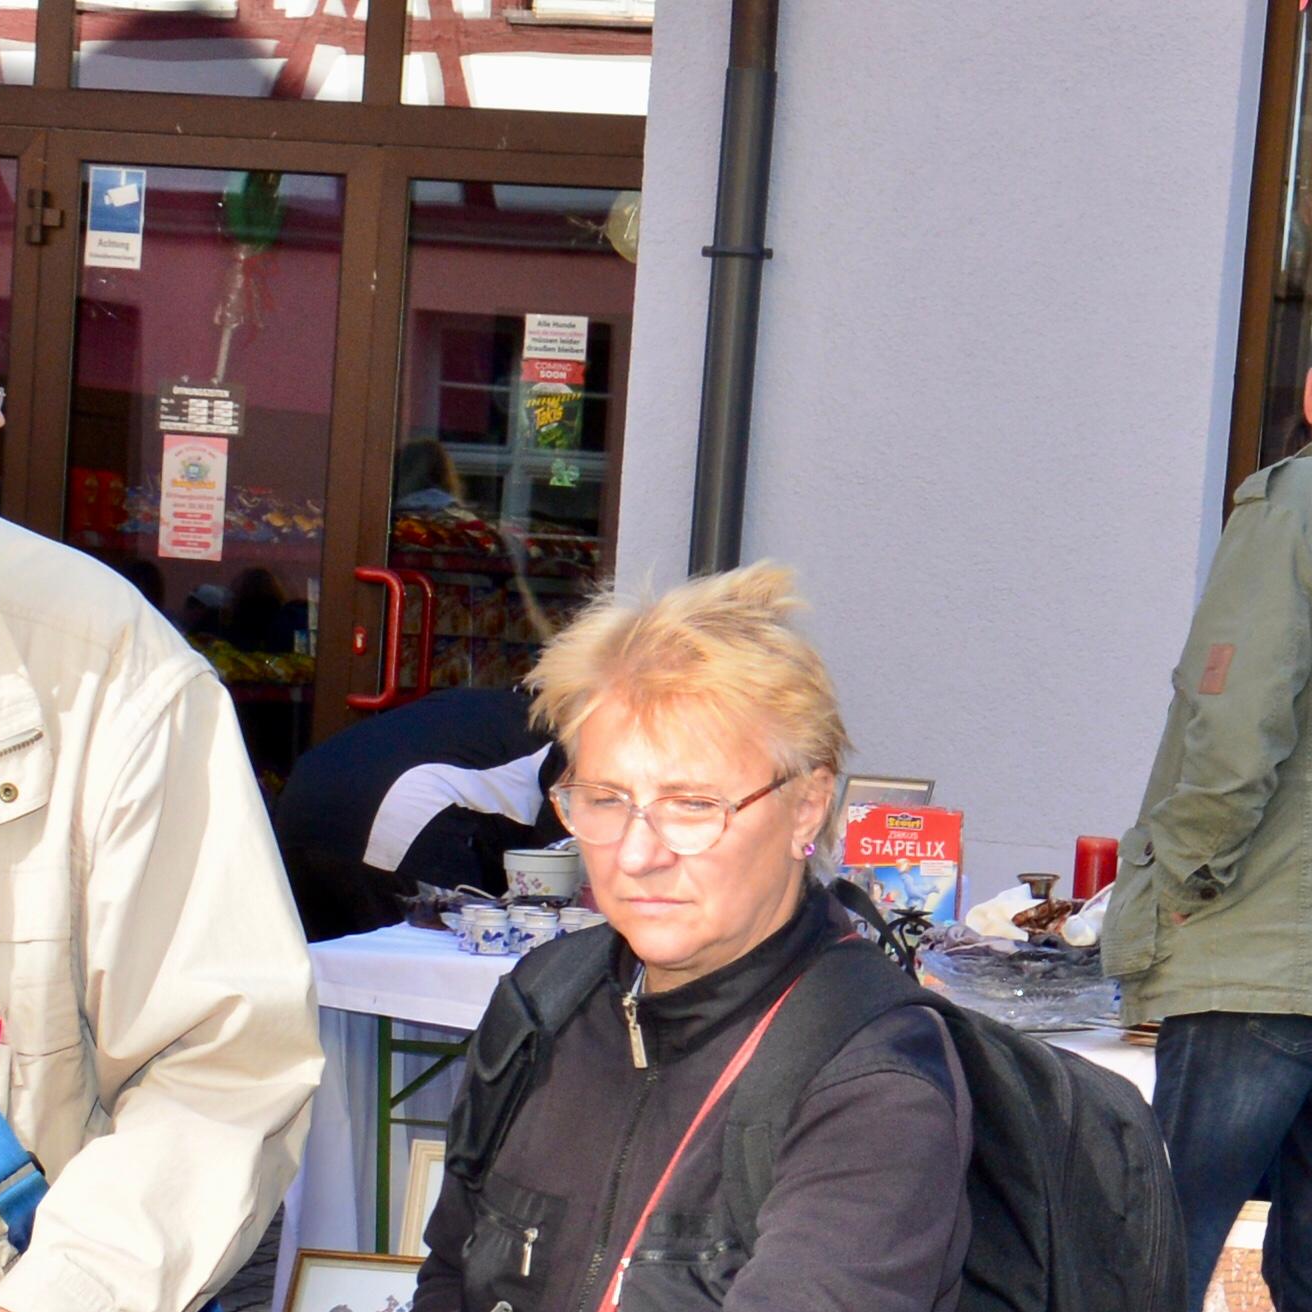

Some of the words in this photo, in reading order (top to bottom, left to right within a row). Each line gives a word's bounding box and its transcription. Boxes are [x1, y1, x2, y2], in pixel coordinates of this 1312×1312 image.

[535, 362, 573, 372] COMING
[540, 370, 568, 380] SOON
[860, 837, 945, 859] STAPELIX
